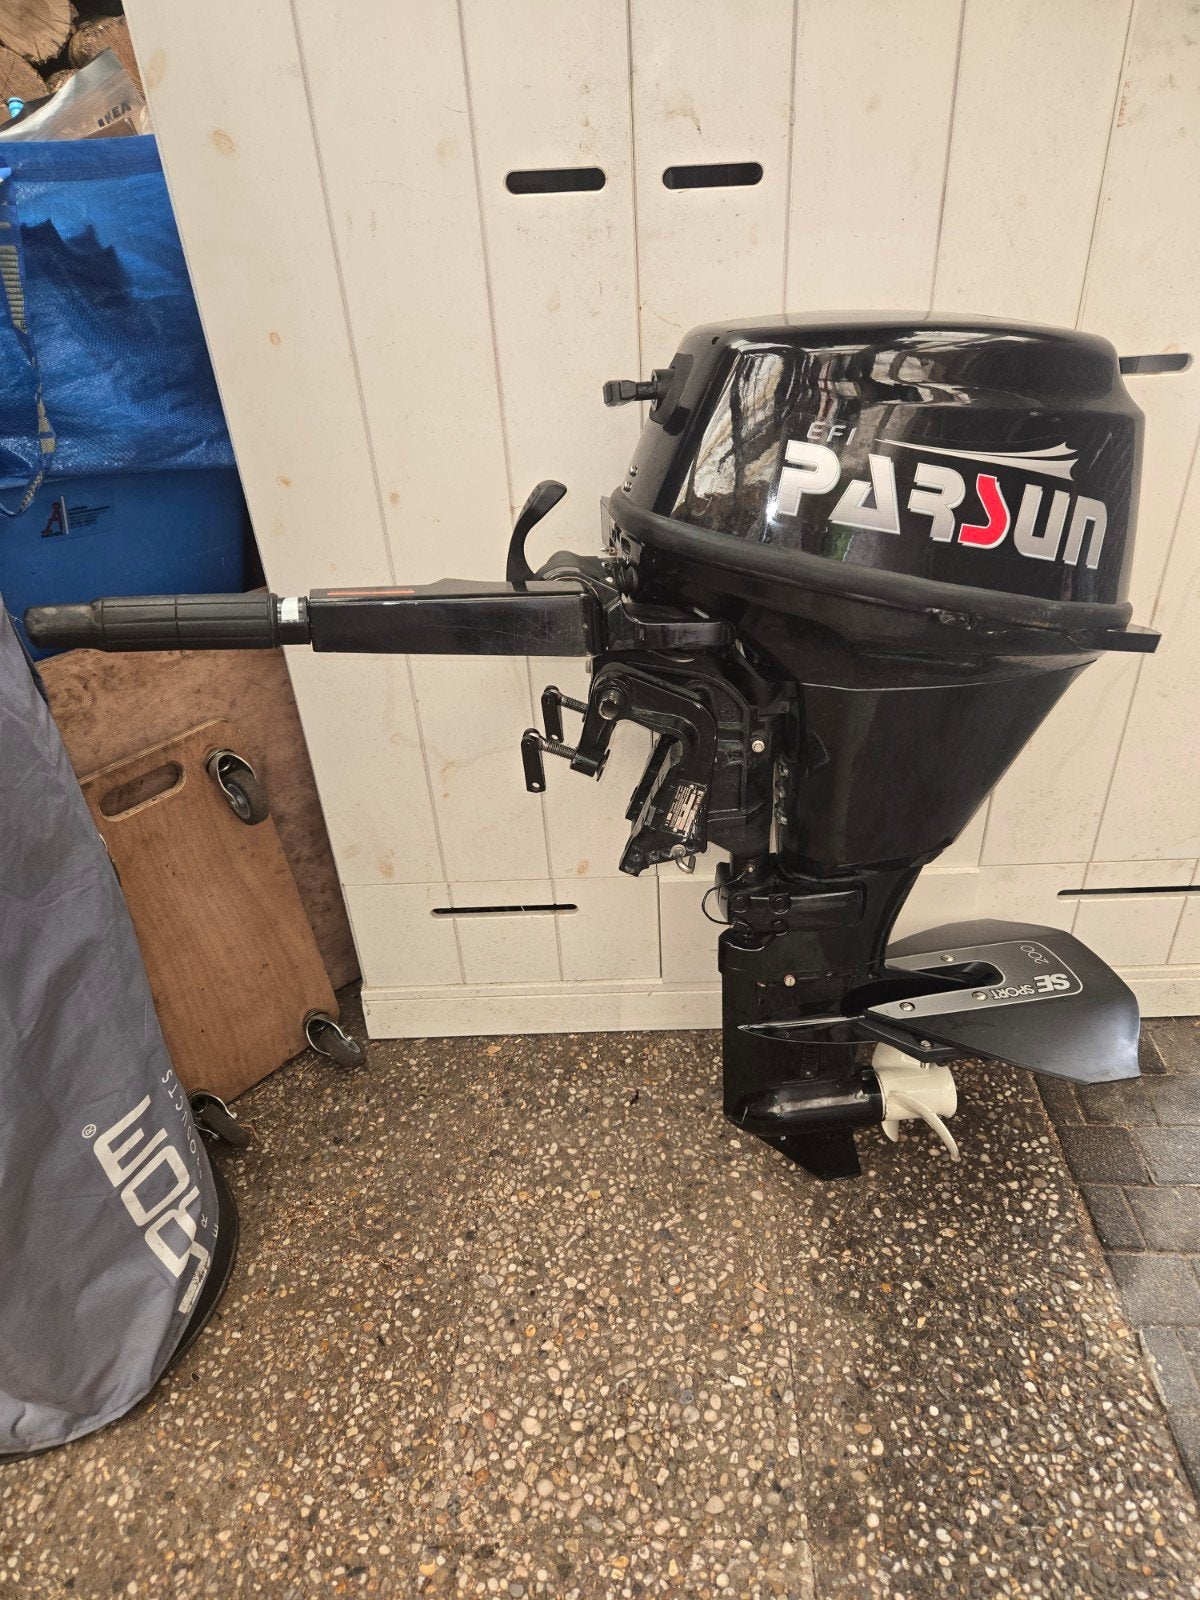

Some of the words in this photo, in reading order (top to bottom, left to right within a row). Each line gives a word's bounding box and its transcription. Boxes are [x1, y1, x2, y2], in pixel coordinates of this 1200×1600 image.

[97, 101, 132, 127] IKEA
[807, 421, 856, 446] EFI
[1020, 945, 1050, 964] 200
[990, 984, 1036, 1000] SPORT
[1033, 973, 1071, 993] SE
